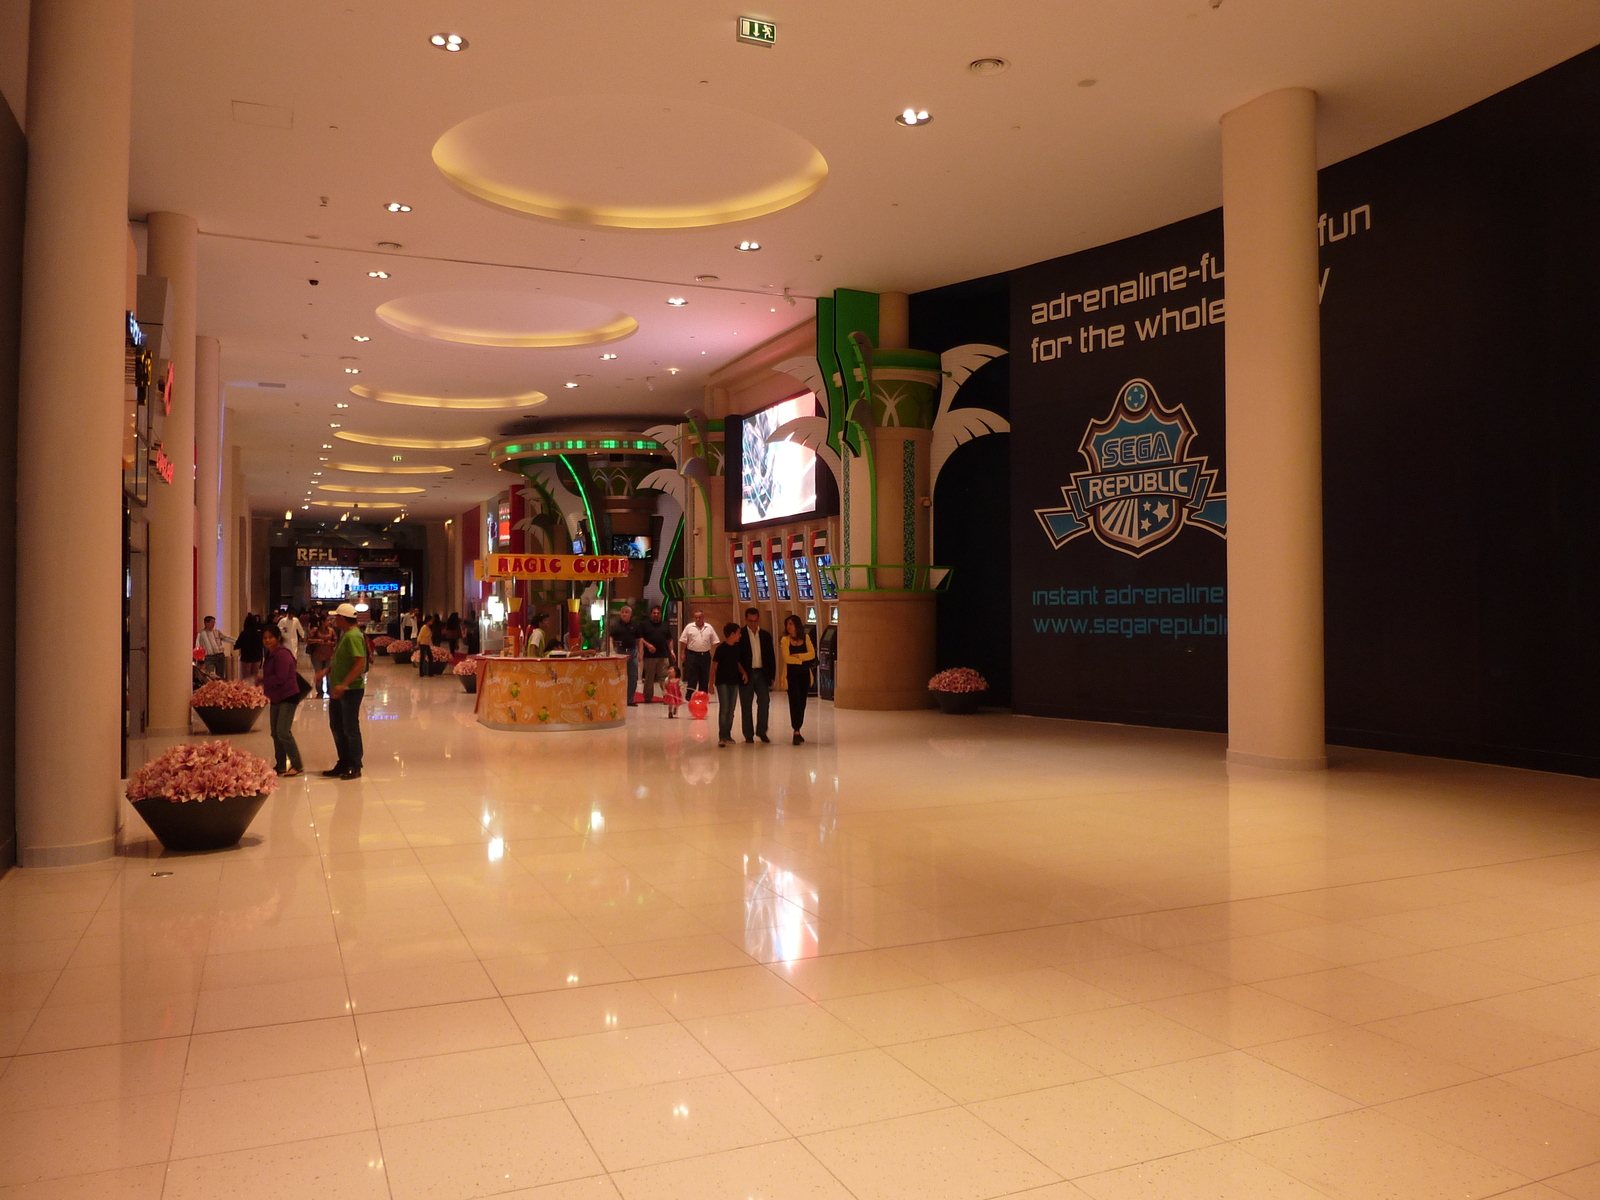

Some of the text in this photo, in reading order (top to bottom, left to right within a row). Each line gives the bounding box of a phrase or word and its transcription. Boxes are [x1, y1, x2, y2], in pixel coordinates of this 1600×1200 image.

[1318, 204, 1371, 247] fun
[1031, 297, 1225, 364] for the whole
[1101, 431, 1173, 469] SEGA
[1089, 468, 1188, 503] REPUBLIC
[498, 557, 562, 574] MAGIC
[1032, 583, 1224, 606] instant adrenaline
